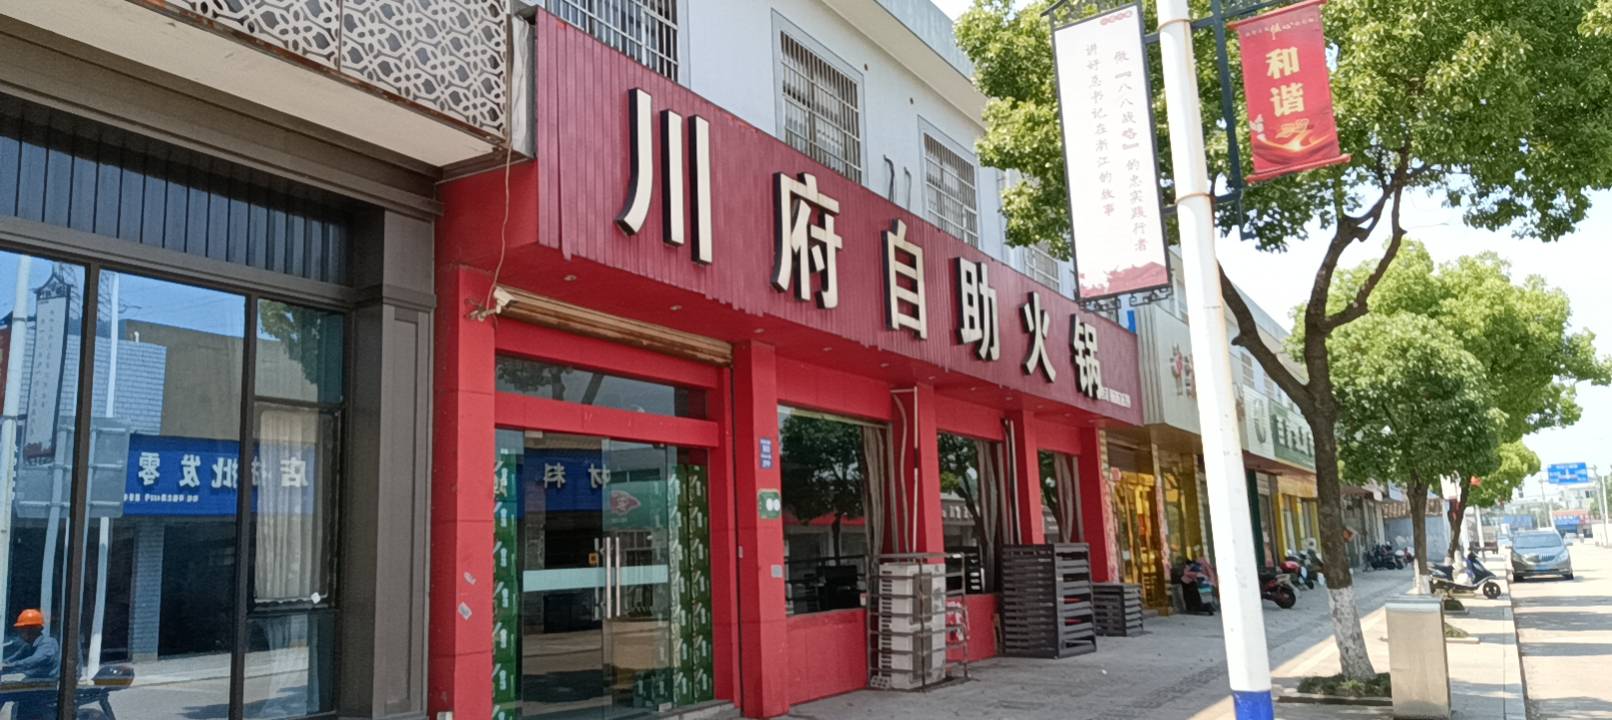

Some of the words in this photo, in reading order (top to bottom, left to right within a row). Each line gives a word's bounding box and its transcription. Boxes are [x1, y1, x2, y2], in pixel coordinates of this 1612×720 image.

[1265, 46, 1305, 117] 和谐
[614, 87, 1102, 401] 川府自助火锅
